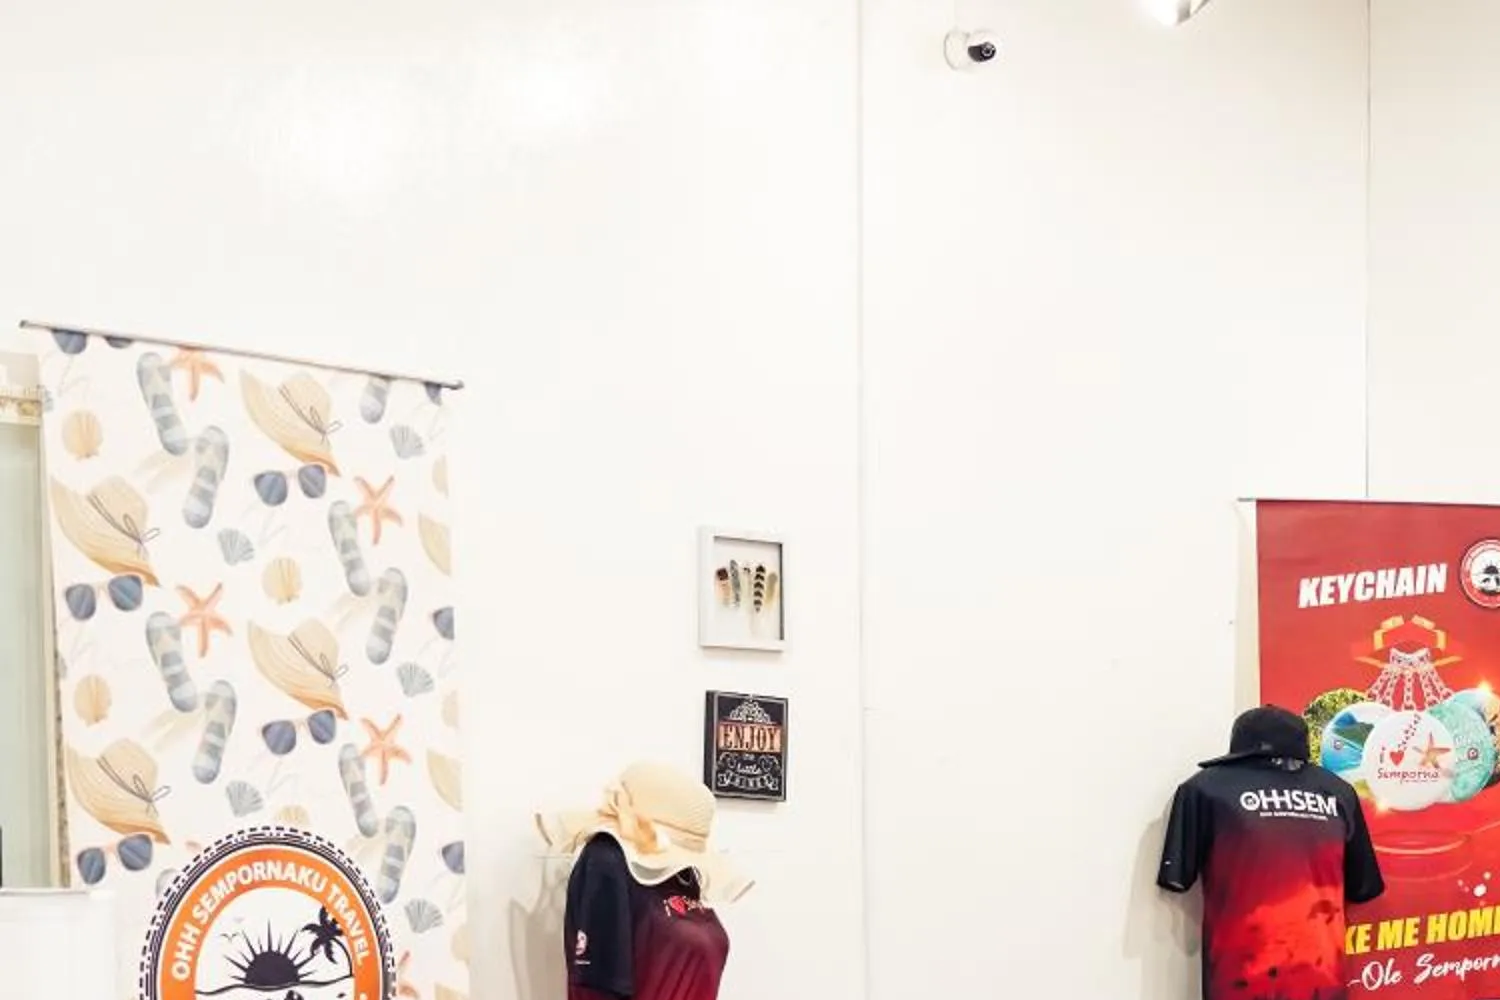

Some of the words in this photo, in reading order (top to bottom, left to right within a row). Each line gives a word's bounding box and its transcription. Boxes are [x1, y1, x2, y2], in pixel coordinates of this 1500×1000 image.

[1298, 563, 1448, 608] KEYCHAIN
[721, 724, 779, 751] ENJOY
[1377, 768, 1439, 784] Semporna
[1240, 789, 1338, 816] OHHSEM
[171, 922, 202, 981] OHH
[191, 860, 329, 924] SEMPORNAKU
[328, 884, 371, 966] TRAVEL
[1345, 924, 1373, 955] KE
[1377, 917, 1420, 951] ME
